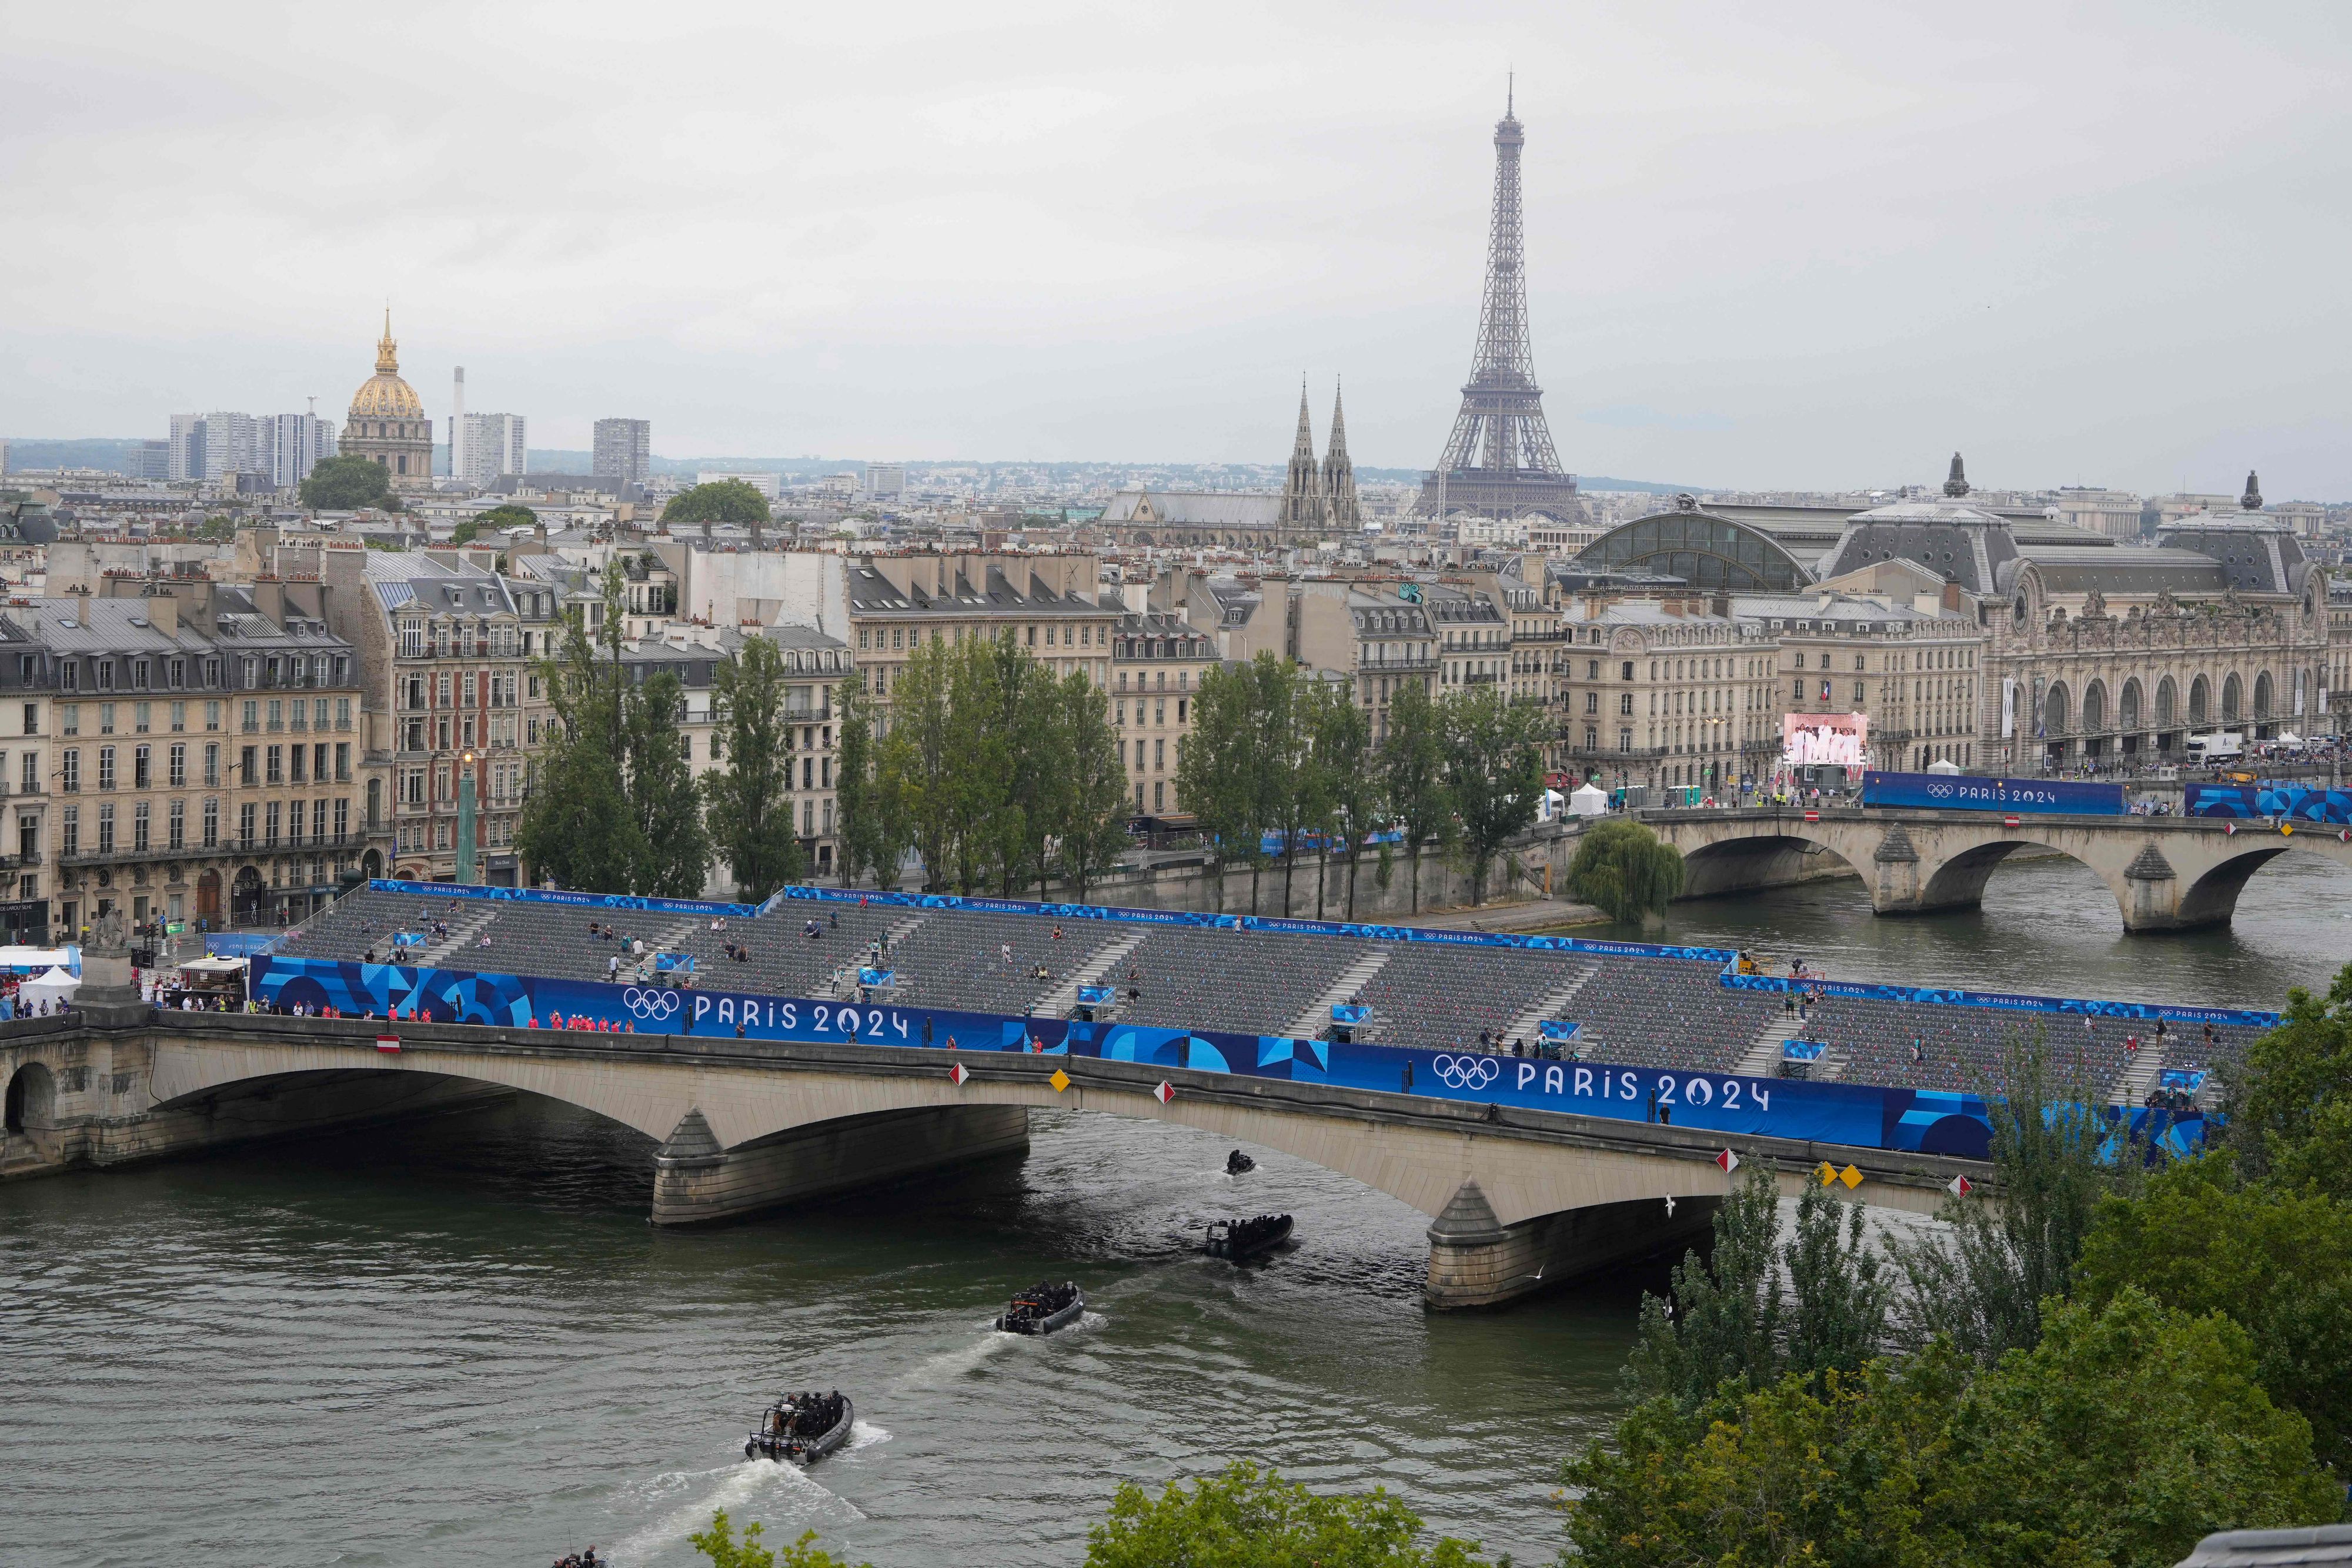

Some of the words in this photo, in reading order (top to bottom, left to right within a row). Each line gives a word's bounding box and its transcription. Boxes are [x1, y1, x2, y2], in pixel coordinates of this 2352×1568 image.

[2013, 790, 2055, 803] 2024
[813, 1006, 907, 1038] 2024
[1657, 1075, 1769, 1111] 2024
